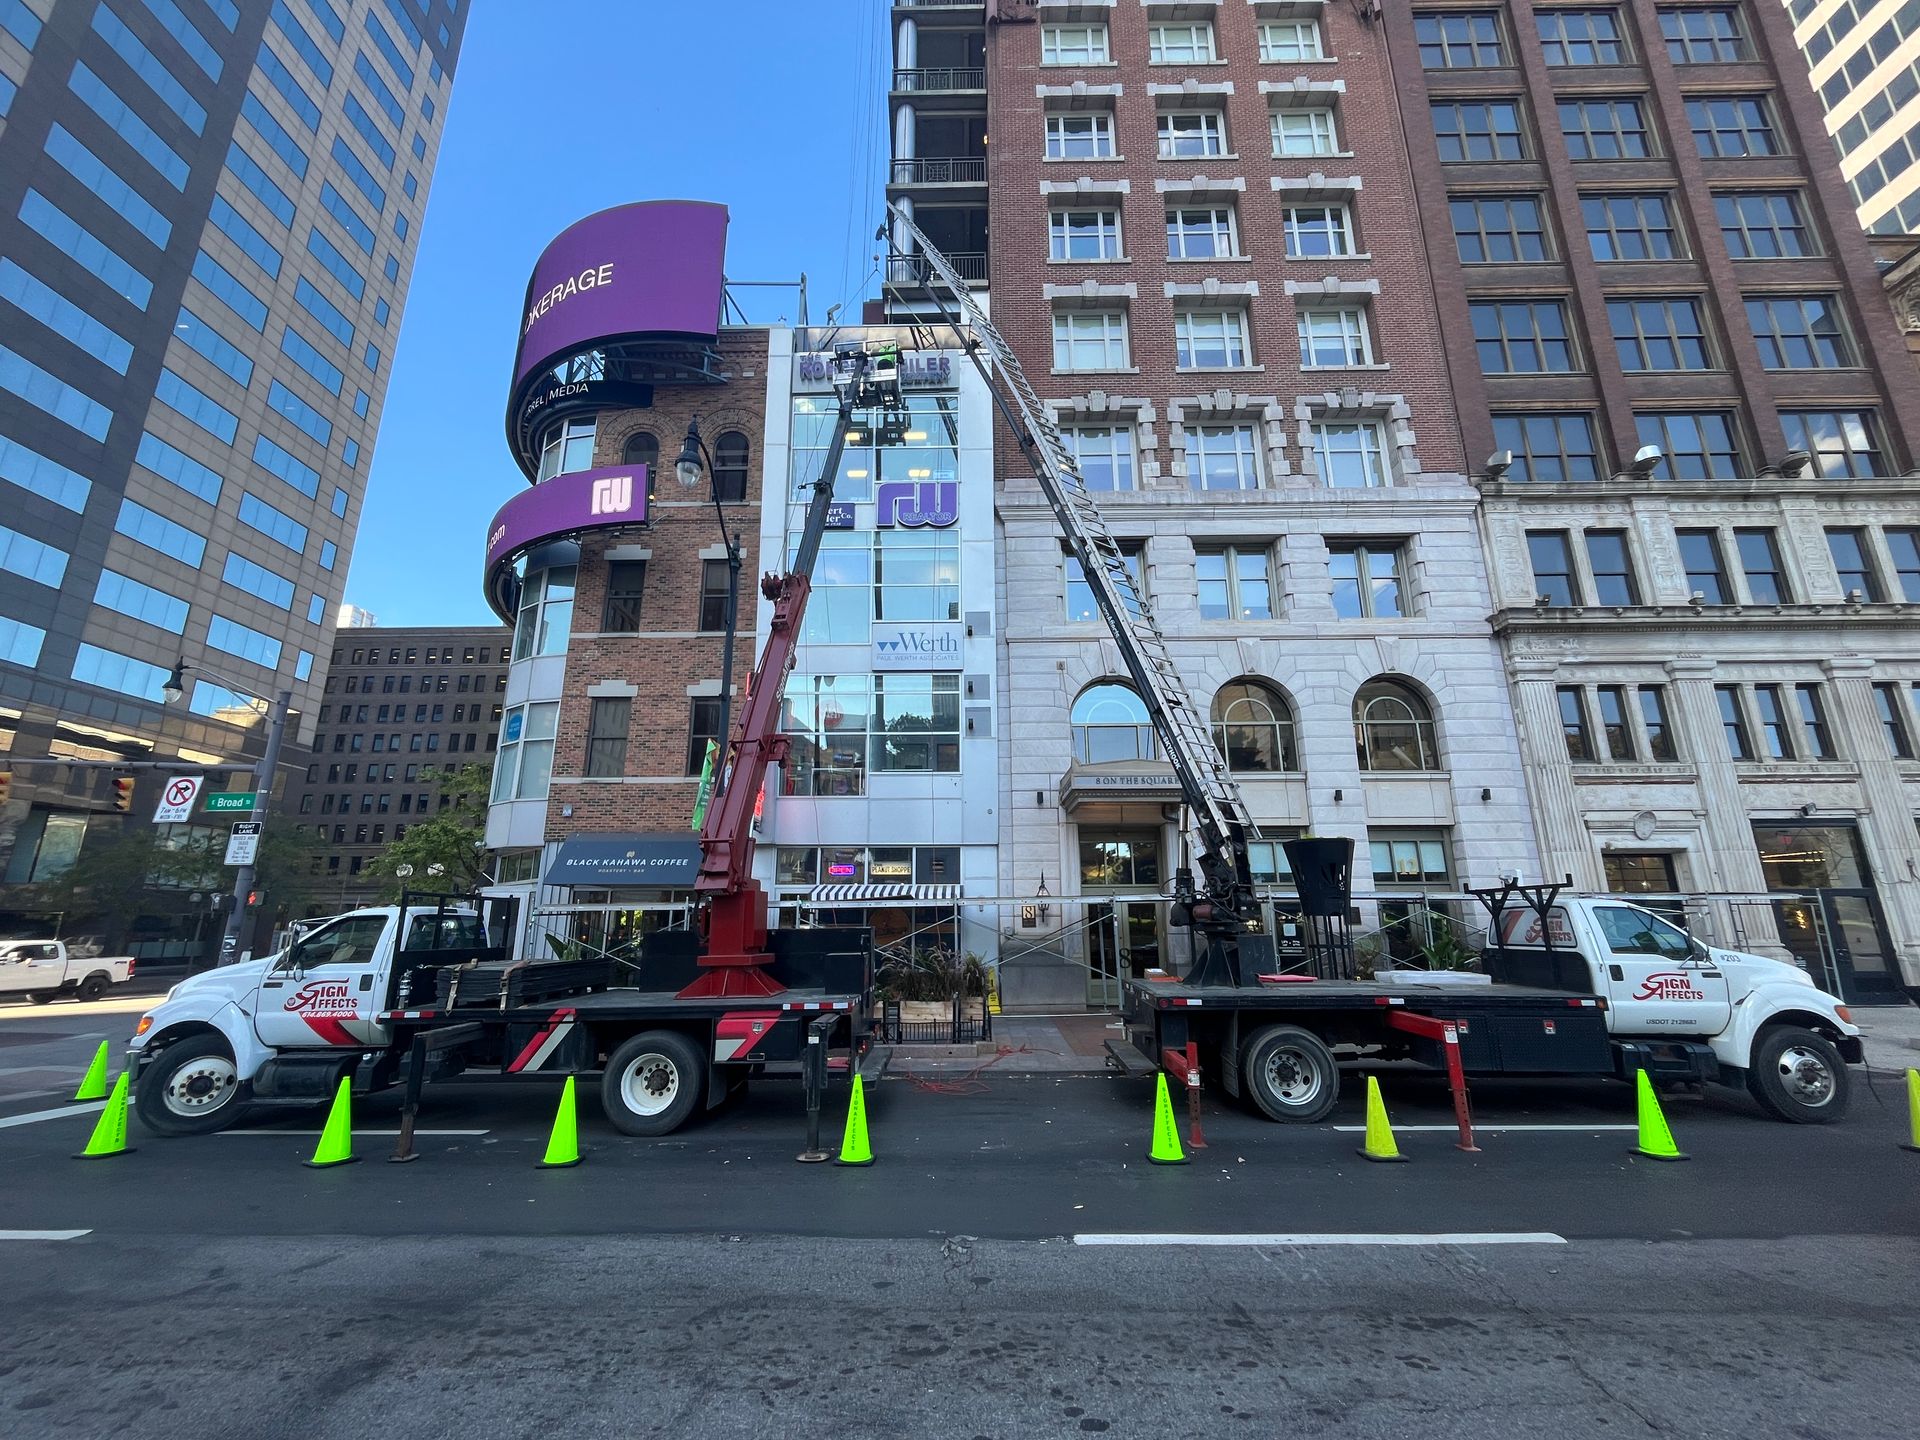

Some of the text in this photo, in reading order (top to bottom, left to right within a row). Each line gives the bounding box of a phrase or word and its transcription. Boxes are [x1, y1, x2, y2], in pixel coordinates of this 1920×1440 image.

[549, 383, 589, 400] MEDIA
[902, 512, 952, 522] REALTOR
[898, 632, 958, 652] Werth
[1163, 736, 1181, 769] SKYHOOK
[1095, 777, 1180, 785] 8 ON THE SQUARE
[217, 798, 244, 807] Broad
[792, 860, 802, 873] 4
[1024, 906, 1033, 919] 8
[1120, 947, 1131, 969] 8
[295, 977, 349, 999] SIGN
[1641, 971, 1691, 990] SIGN
